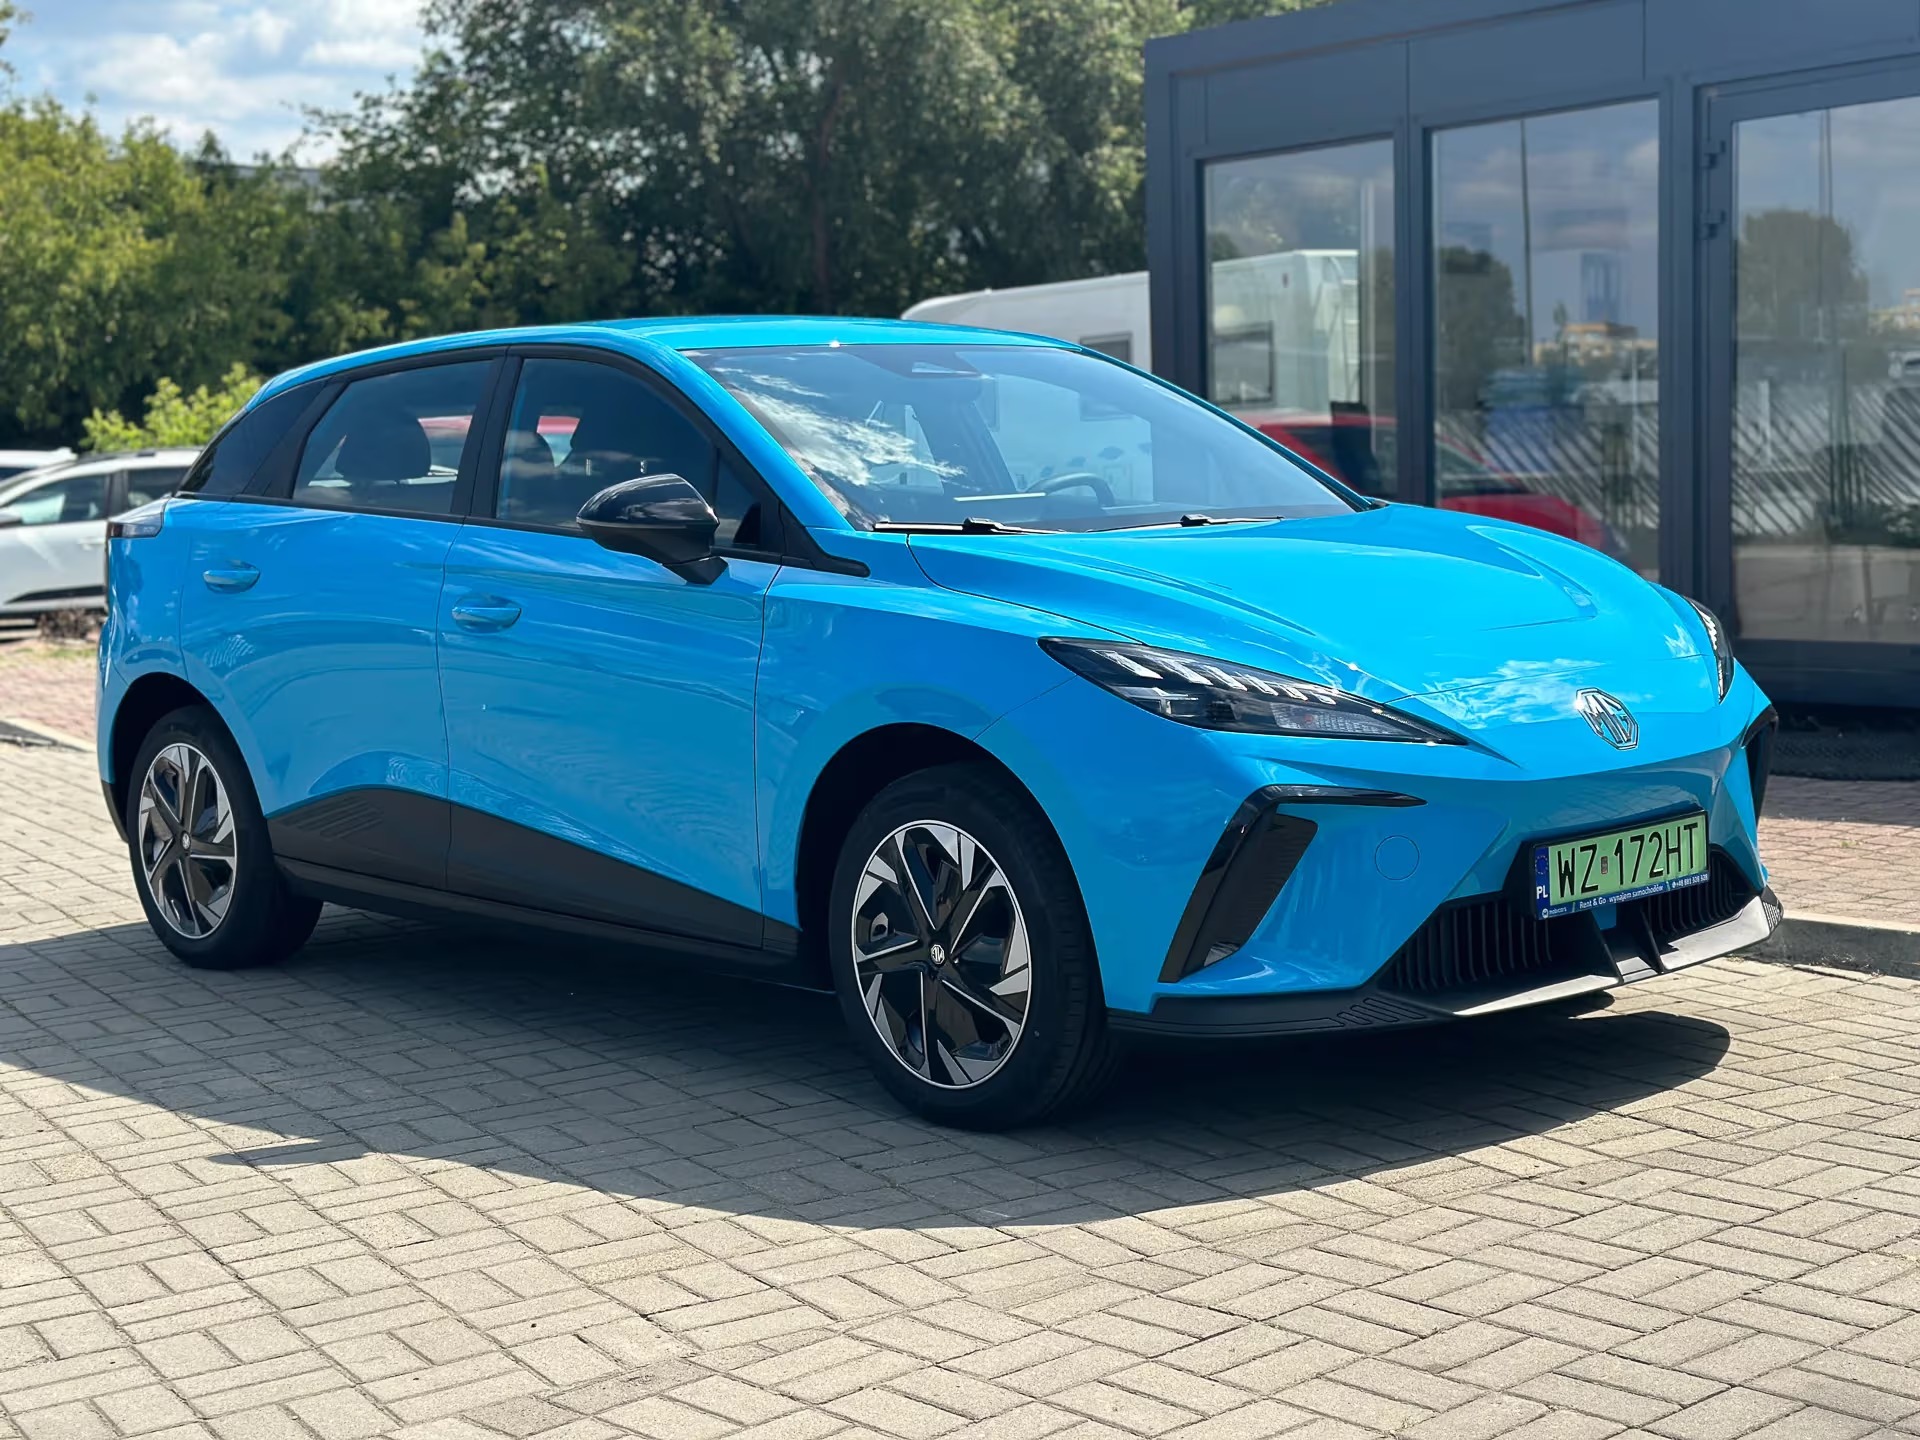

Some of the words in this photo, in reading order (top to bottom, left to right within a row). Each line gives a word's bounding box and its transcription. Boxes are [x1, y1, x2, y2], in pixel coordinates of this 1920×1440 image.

[1577, 688, 1637, 749] MG
[1557, 843, 1599, 898] WZ
[1613, 822, 1699, 886] 172HT
[1536, 886, 1549, 899] PL
[1579, 901, 1592, 909] Rent
[1592, 898, 1598, 906] &
[1598, 896, 1607, 905] Go
[1608, 892, 1632, 904] wynajem
[1632, 884, 1664, 898] samochodów
